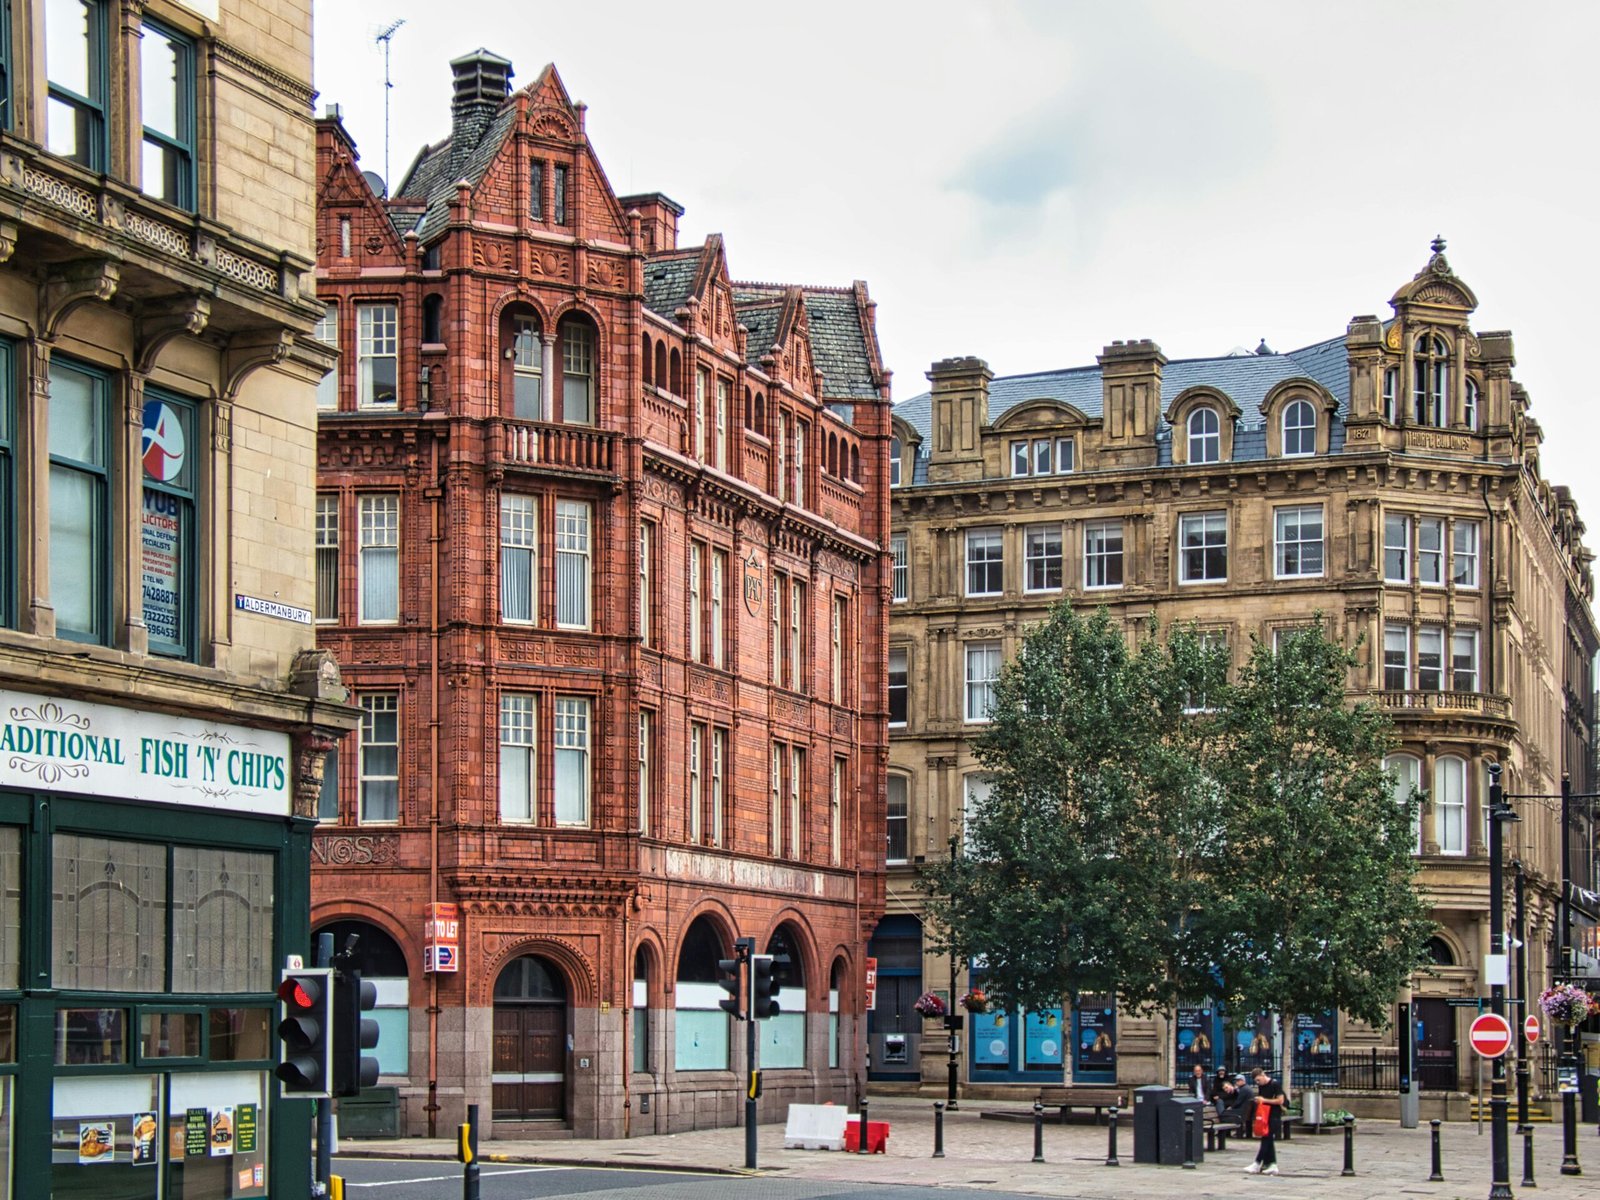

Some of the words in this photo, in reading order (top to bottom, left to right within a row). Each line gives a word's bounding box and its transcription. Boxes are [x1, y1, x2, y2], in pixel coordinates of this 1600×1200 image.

[245, 599, 308, 621] ALDERMANBURY
[0, 724, 125, 765] ADITIONAL
[140, 737, 188, 779] FISH
[228, 750, 286, 791] CHIPS
[434, 920, 446, 938] TO
[446, 921, 459, 938] LET
